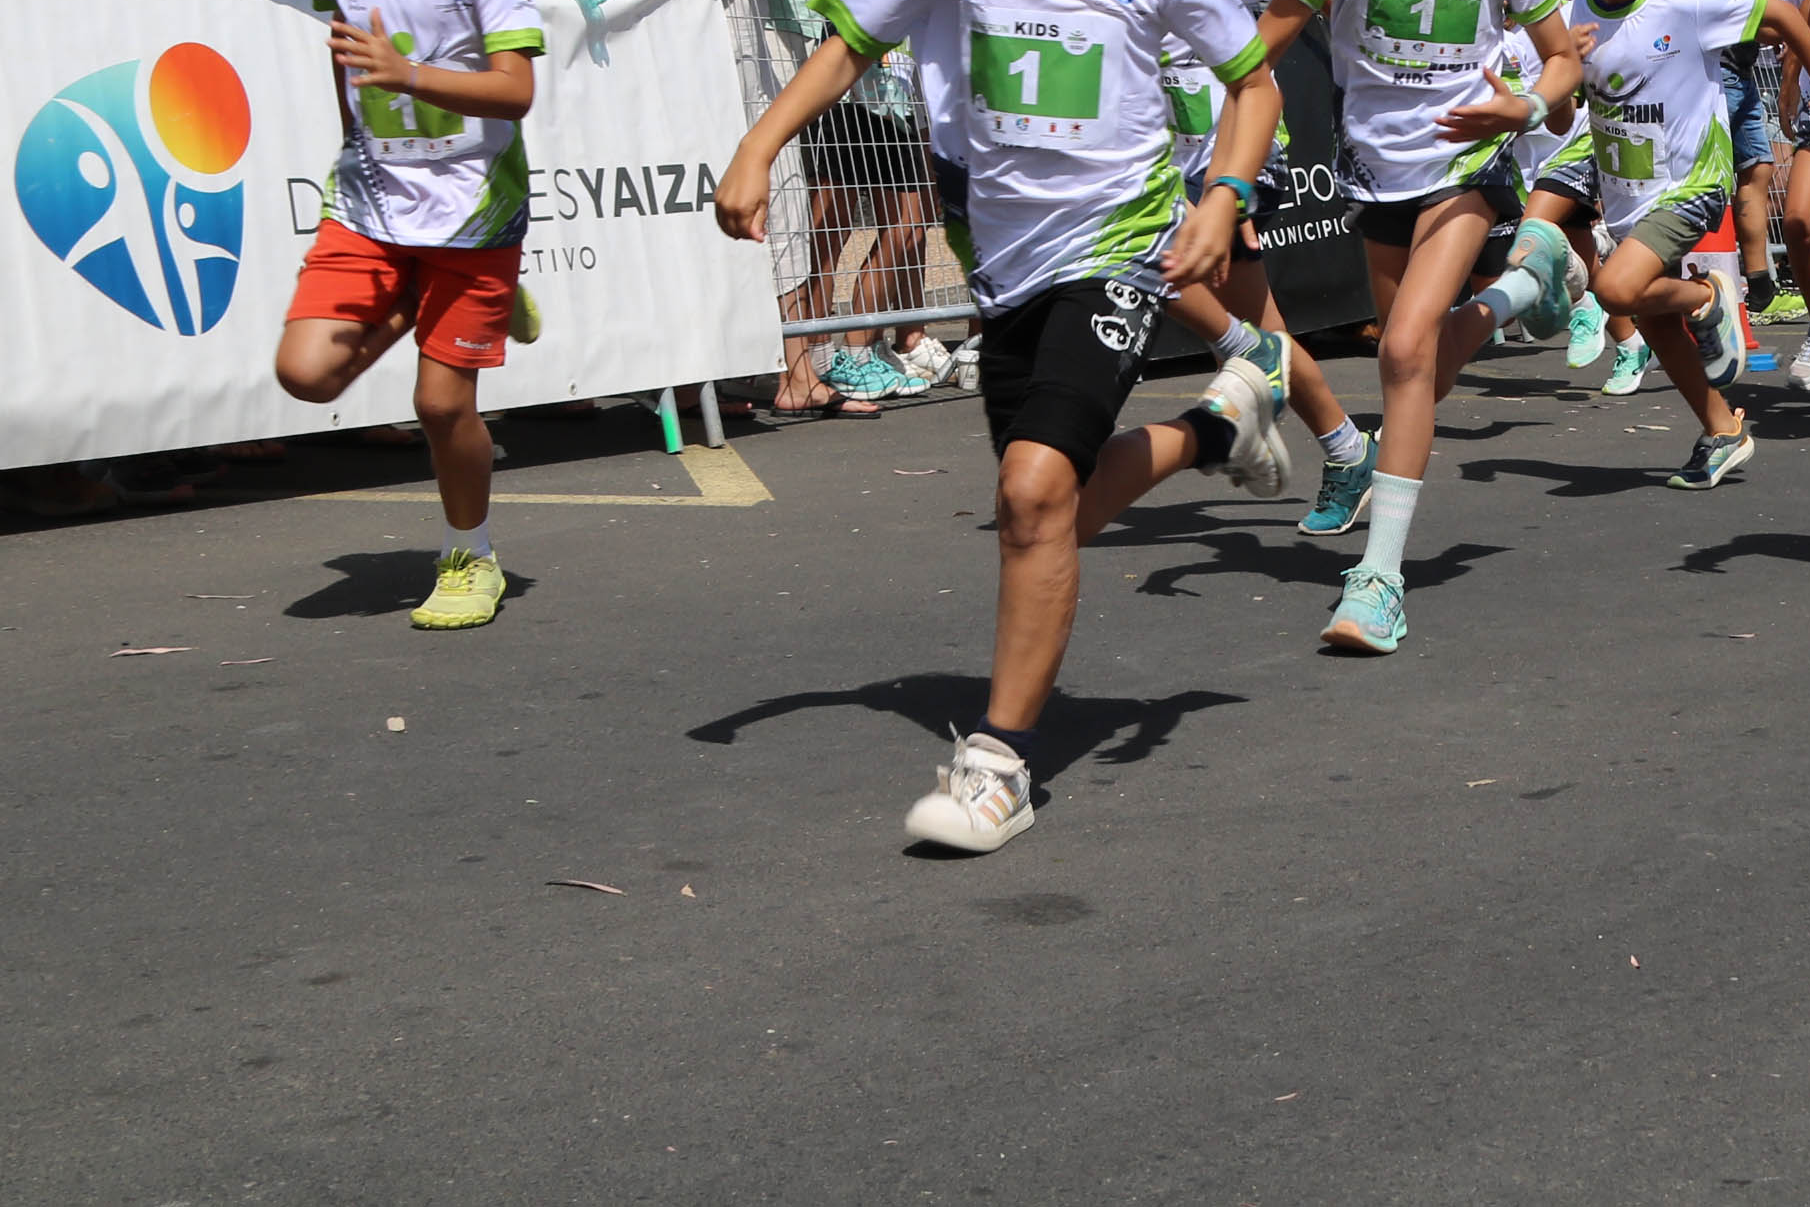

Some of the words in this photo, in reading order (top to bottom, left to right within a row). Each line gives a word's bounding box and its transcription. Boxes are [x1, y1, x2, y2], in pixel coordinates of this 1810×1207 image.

[1015, 21, 1060, 38] KIDS
[1008, 50, 1041, 105] 1
[1161, 75, 1180, 86] IDS
[389, 93, 418, 131] 1
[1604, 125, 1628, 137] KIDS
[1605, 142, 1620, 172] 1
[519, 246, 597, 274] CTIVO
